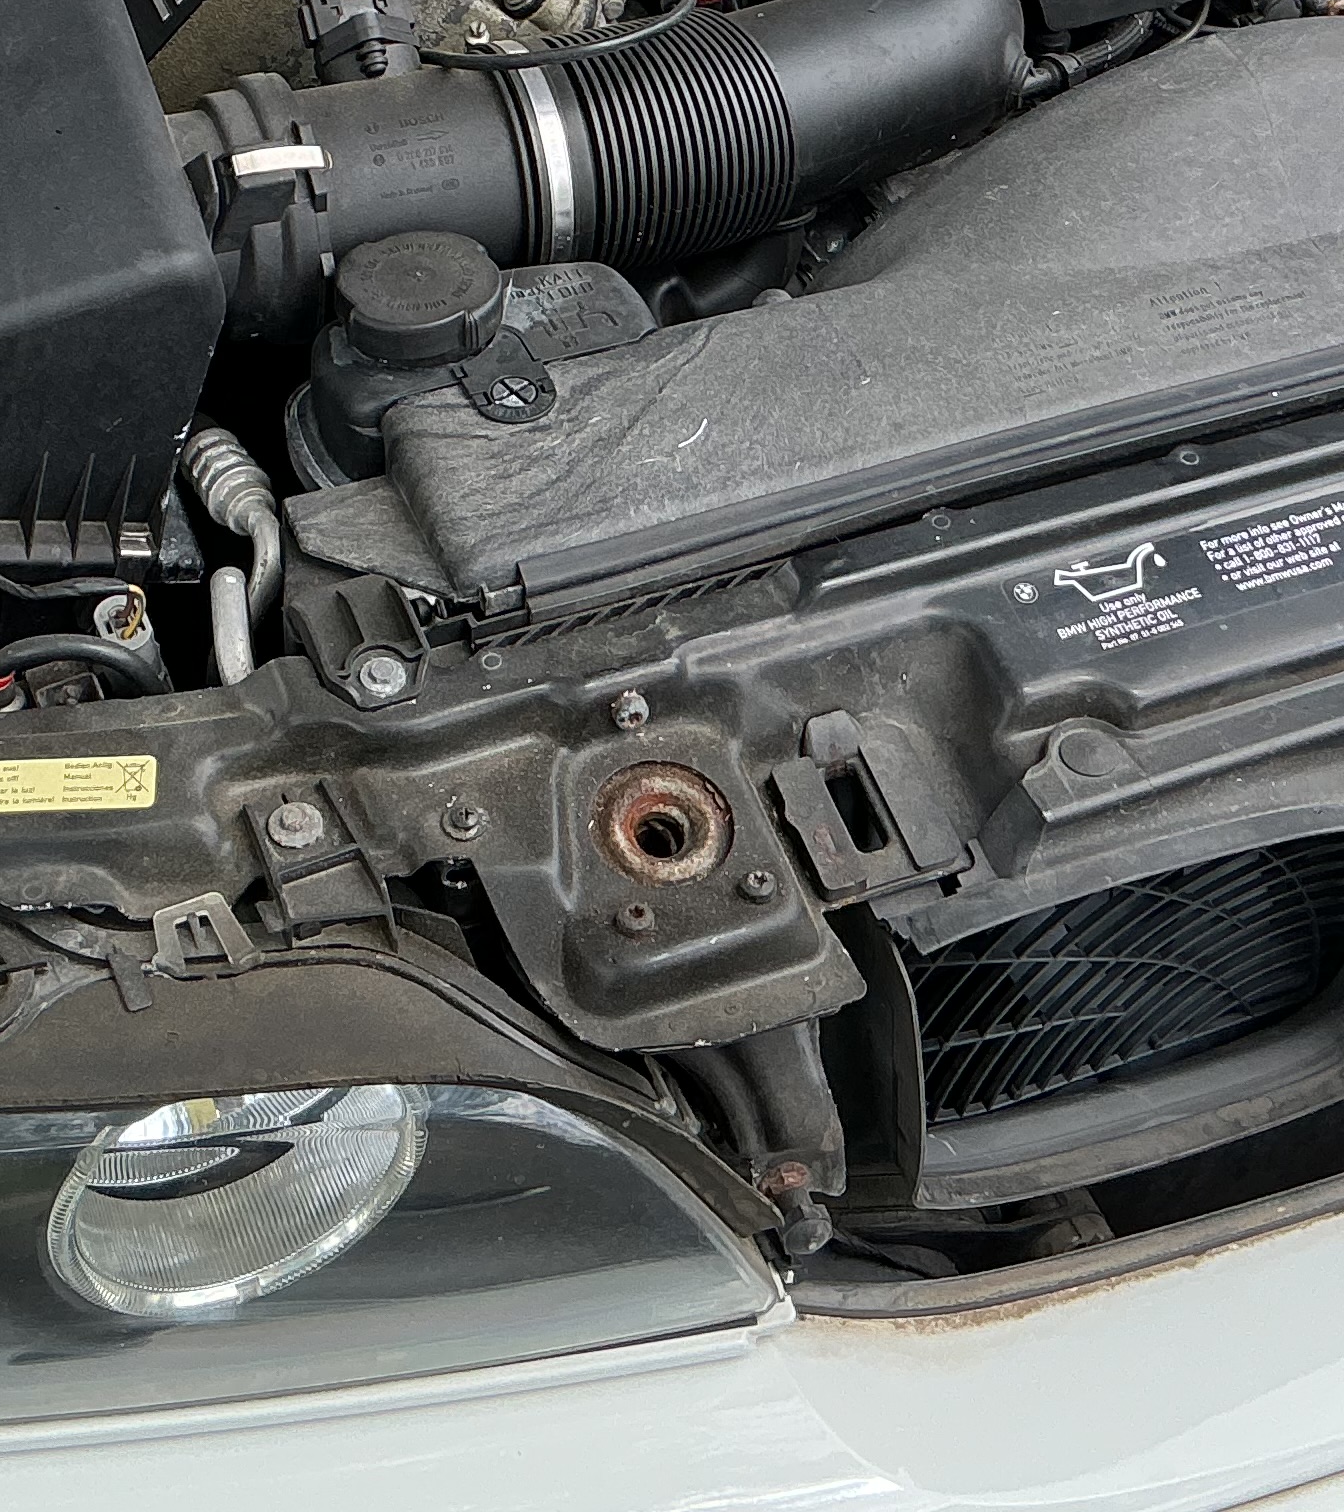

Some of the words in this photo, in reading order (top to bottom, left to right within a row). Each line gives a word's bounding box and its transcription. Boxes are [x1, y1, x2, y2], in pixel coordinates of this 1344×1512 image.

[1199, 539, 1219, 551] For
[1220, 531, 1249, 545] more
[1249, 525, 1270, 537] info
[1270, 519, 1290, 531] see
[1289, 506, 1333, 525] Owner's
[1206, 550, 1226, 562] For
[1227, 547, 1235, 556] a
[1235, 542, 1254, 553] list
[1254, 538, 1265, 549] of
[1265, 530, 1294, 545] other
[1294, 515, 1342, 537] approved
[1223, 556, 1244, 570] call
[1230, 570, 1243, 580] or
[1243, 562, 1266, 577] visit
[1267, 559, 1285, 570] our
[1285, 550, 1308, 564] web
[1308, 545, 1328, 558] site
[1328, 541, 1342, 552] at
[1235, 557, 1334, 591] www.bmwusa.com
[1057, 621, 1087, 640] BMW
[1087, 614, 1118, 631] HIGH
[1117, 587, 1203, 621] PERFORMANCE
[1099, 602, 1122, 612] Use
[1123, 592, 1147, 607] only
[1095, 614, 1157, 641] SYNTHETIC
[1157, 608, 1179, 622] OIL
